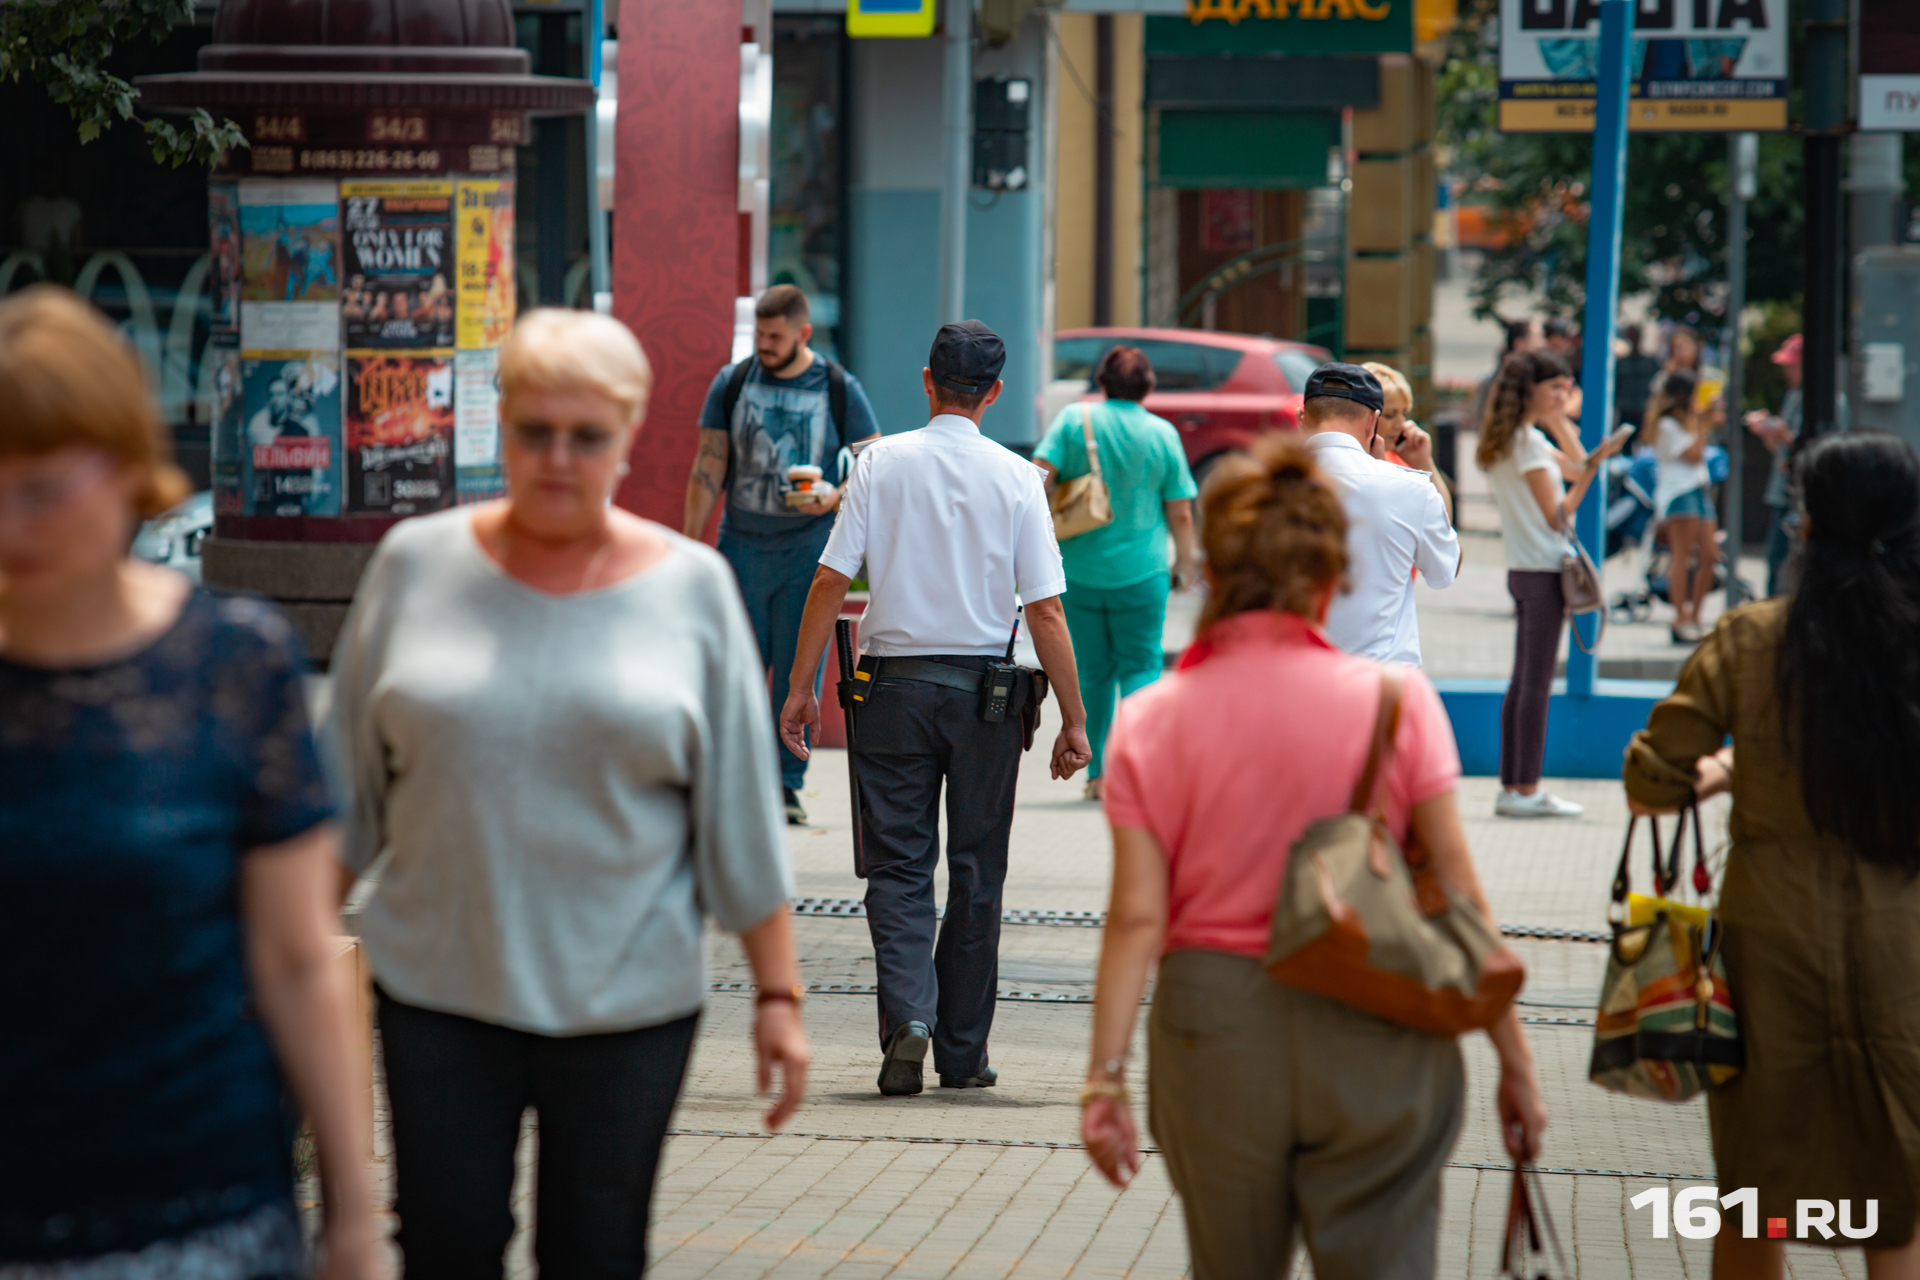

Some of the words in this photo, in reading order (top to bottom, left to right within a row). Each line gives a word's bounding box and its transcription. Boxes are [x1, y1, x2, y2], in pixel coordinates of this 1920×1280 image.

[1186, 0, 1392, 27] ДАМАС
[371, 117, 425, 140] 54/3
[352, 228, 400, 249] ONLY
[404, 228, 444, 249] FOR
[356, 246, 441, 269] WOMEN
